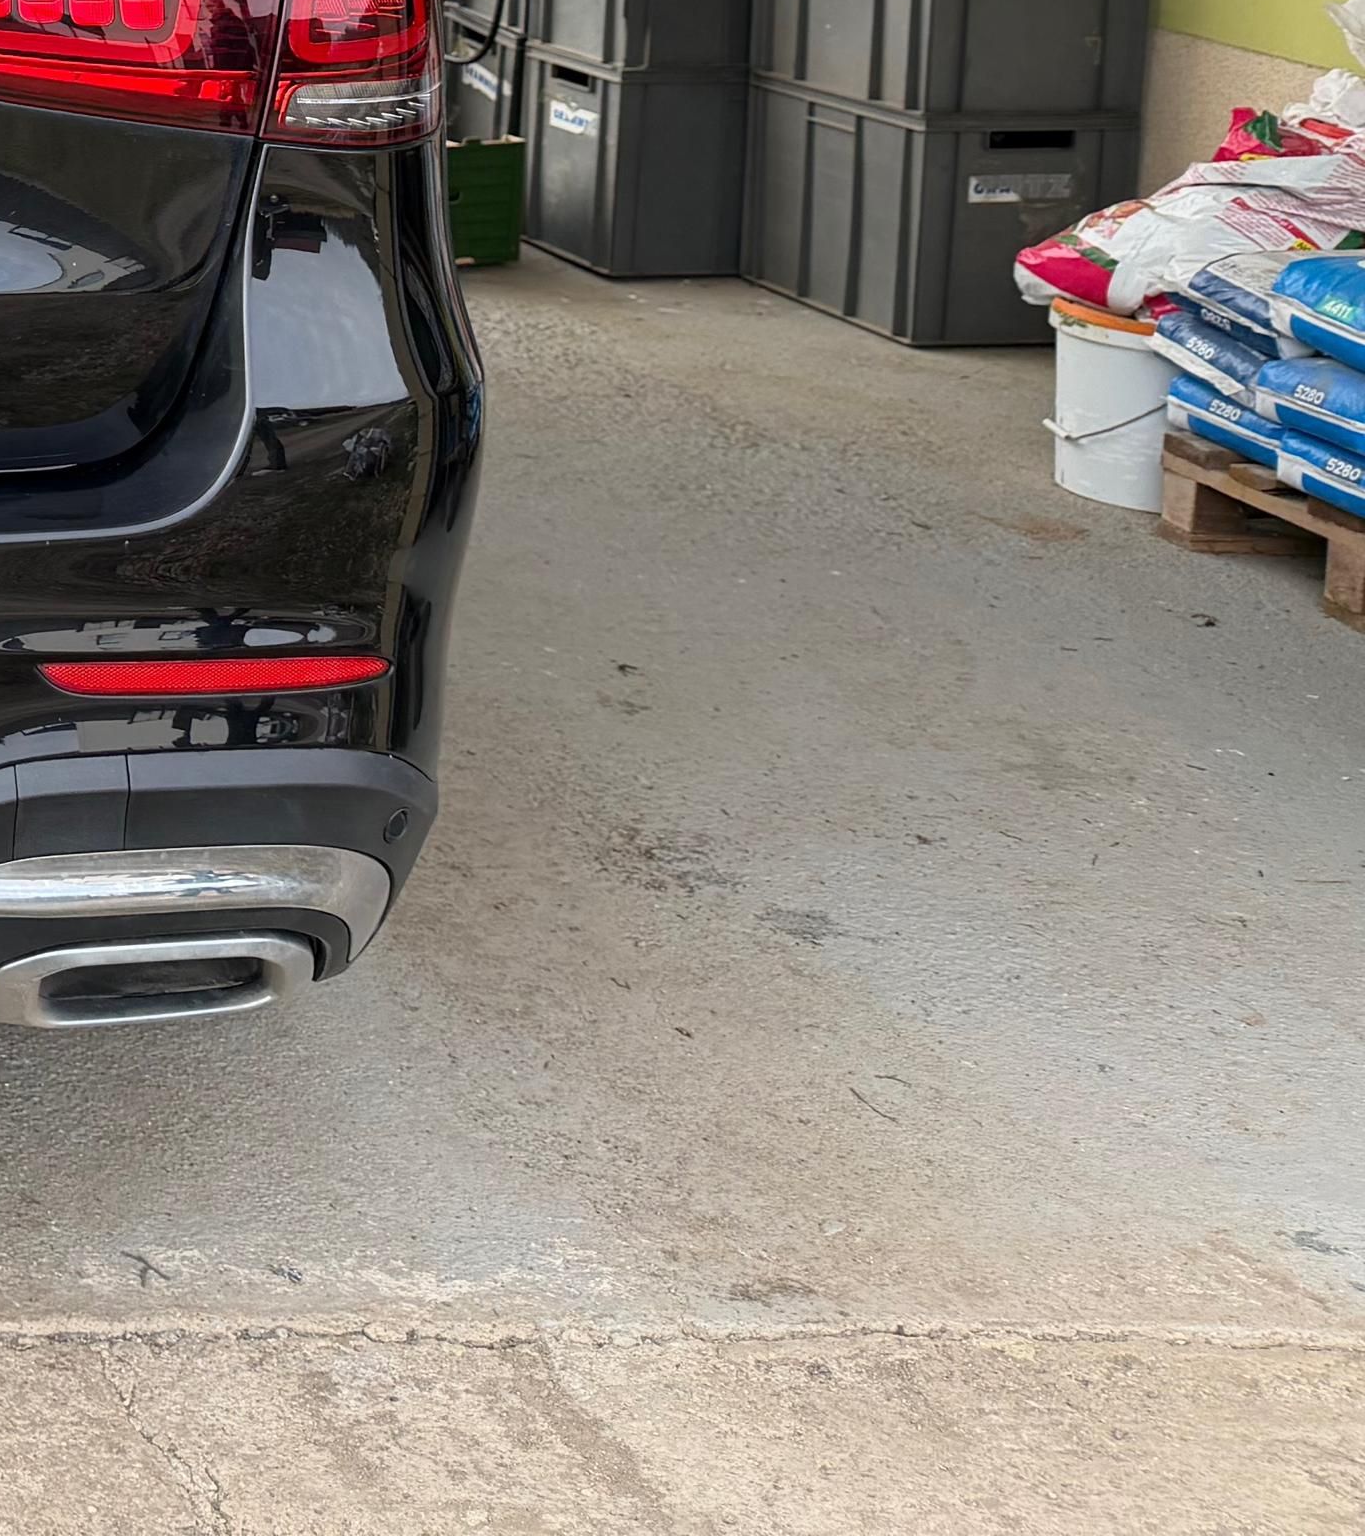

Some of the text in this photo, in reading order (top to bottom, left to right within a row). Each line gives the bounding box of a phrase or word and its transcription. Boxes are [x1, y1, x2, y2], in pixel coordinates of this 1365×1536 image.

[1185, 337, 1215, 360] 5280
[1294, 384, 1325, 404] 5280
[1208, 399, 1241, 421] 5280
[1325, 458, 1362, 481] 5280
